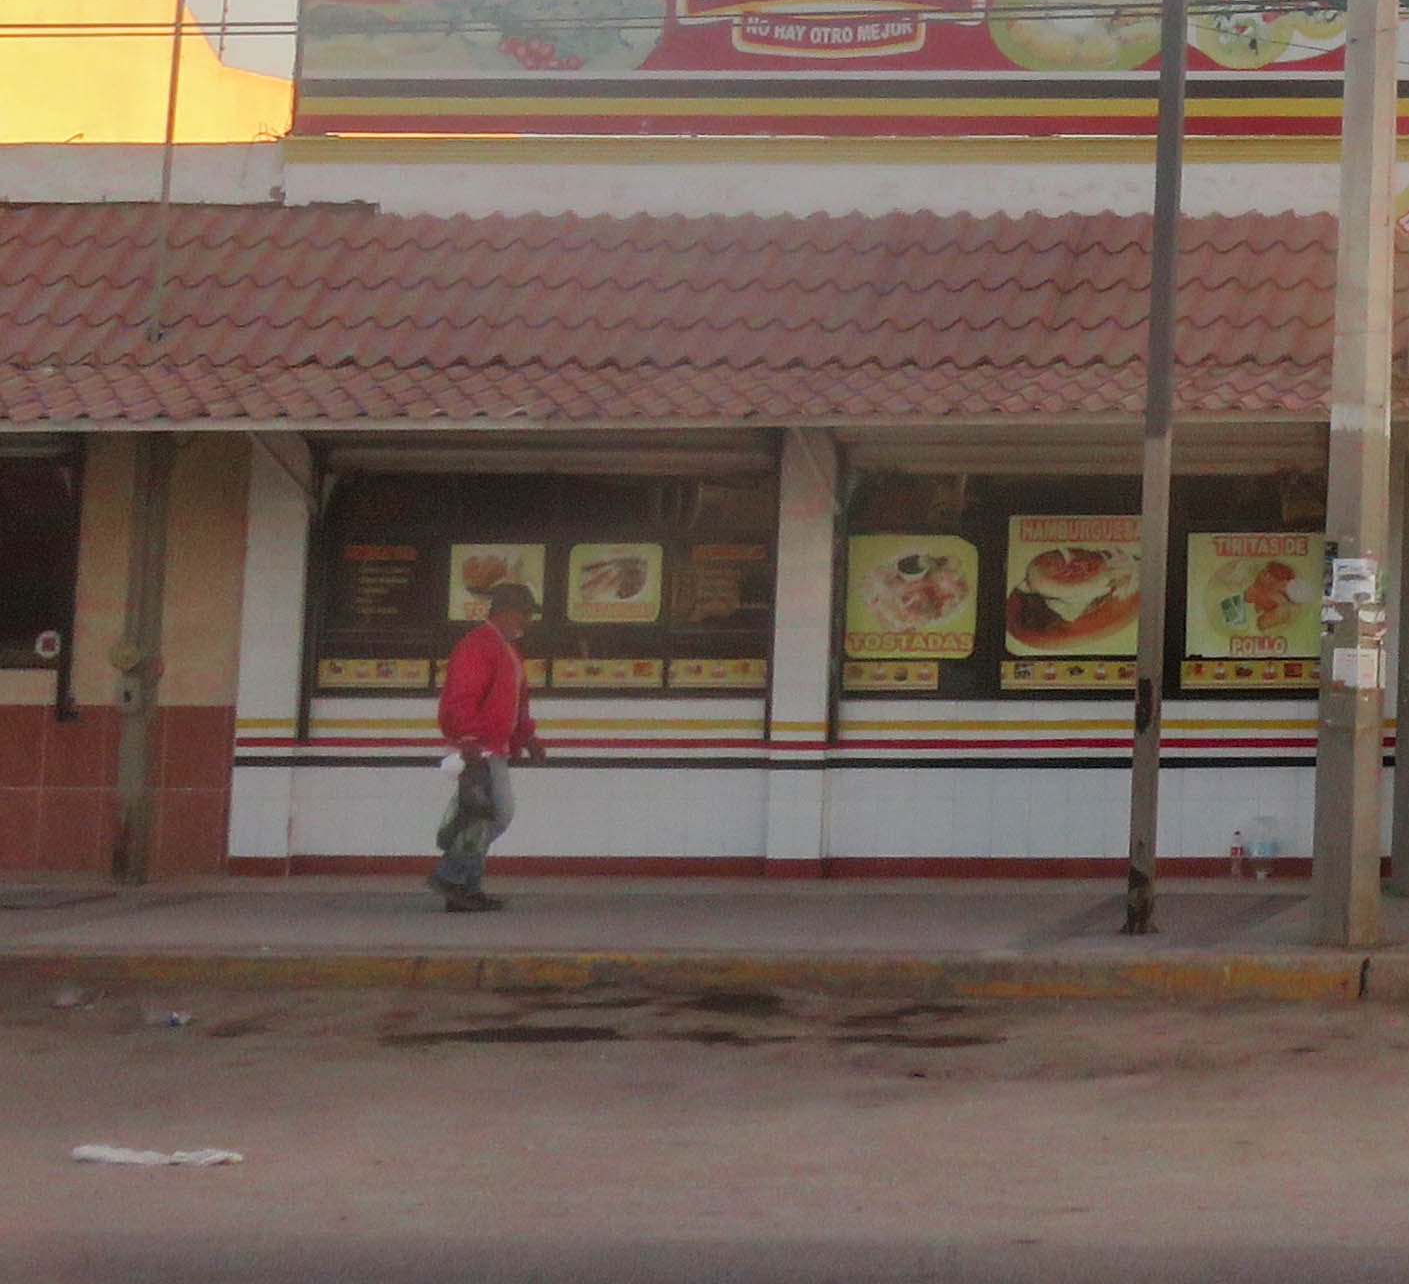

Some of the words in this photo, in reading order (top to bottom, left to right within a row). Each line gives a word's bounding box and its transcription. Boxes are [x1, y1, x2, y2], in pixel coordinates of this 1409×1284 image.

[746, 16, 770, 37] NO
[774, 20, 805, 40] HAY
[810, 23, 853, 44] OTRO
[857, 18, 914, 43] MEJOR
[1284, 535, 1309, 556] DE
[848, 631, 976, 652] TOSTADAS
[1229, 635, 1288, 655] POLLO
